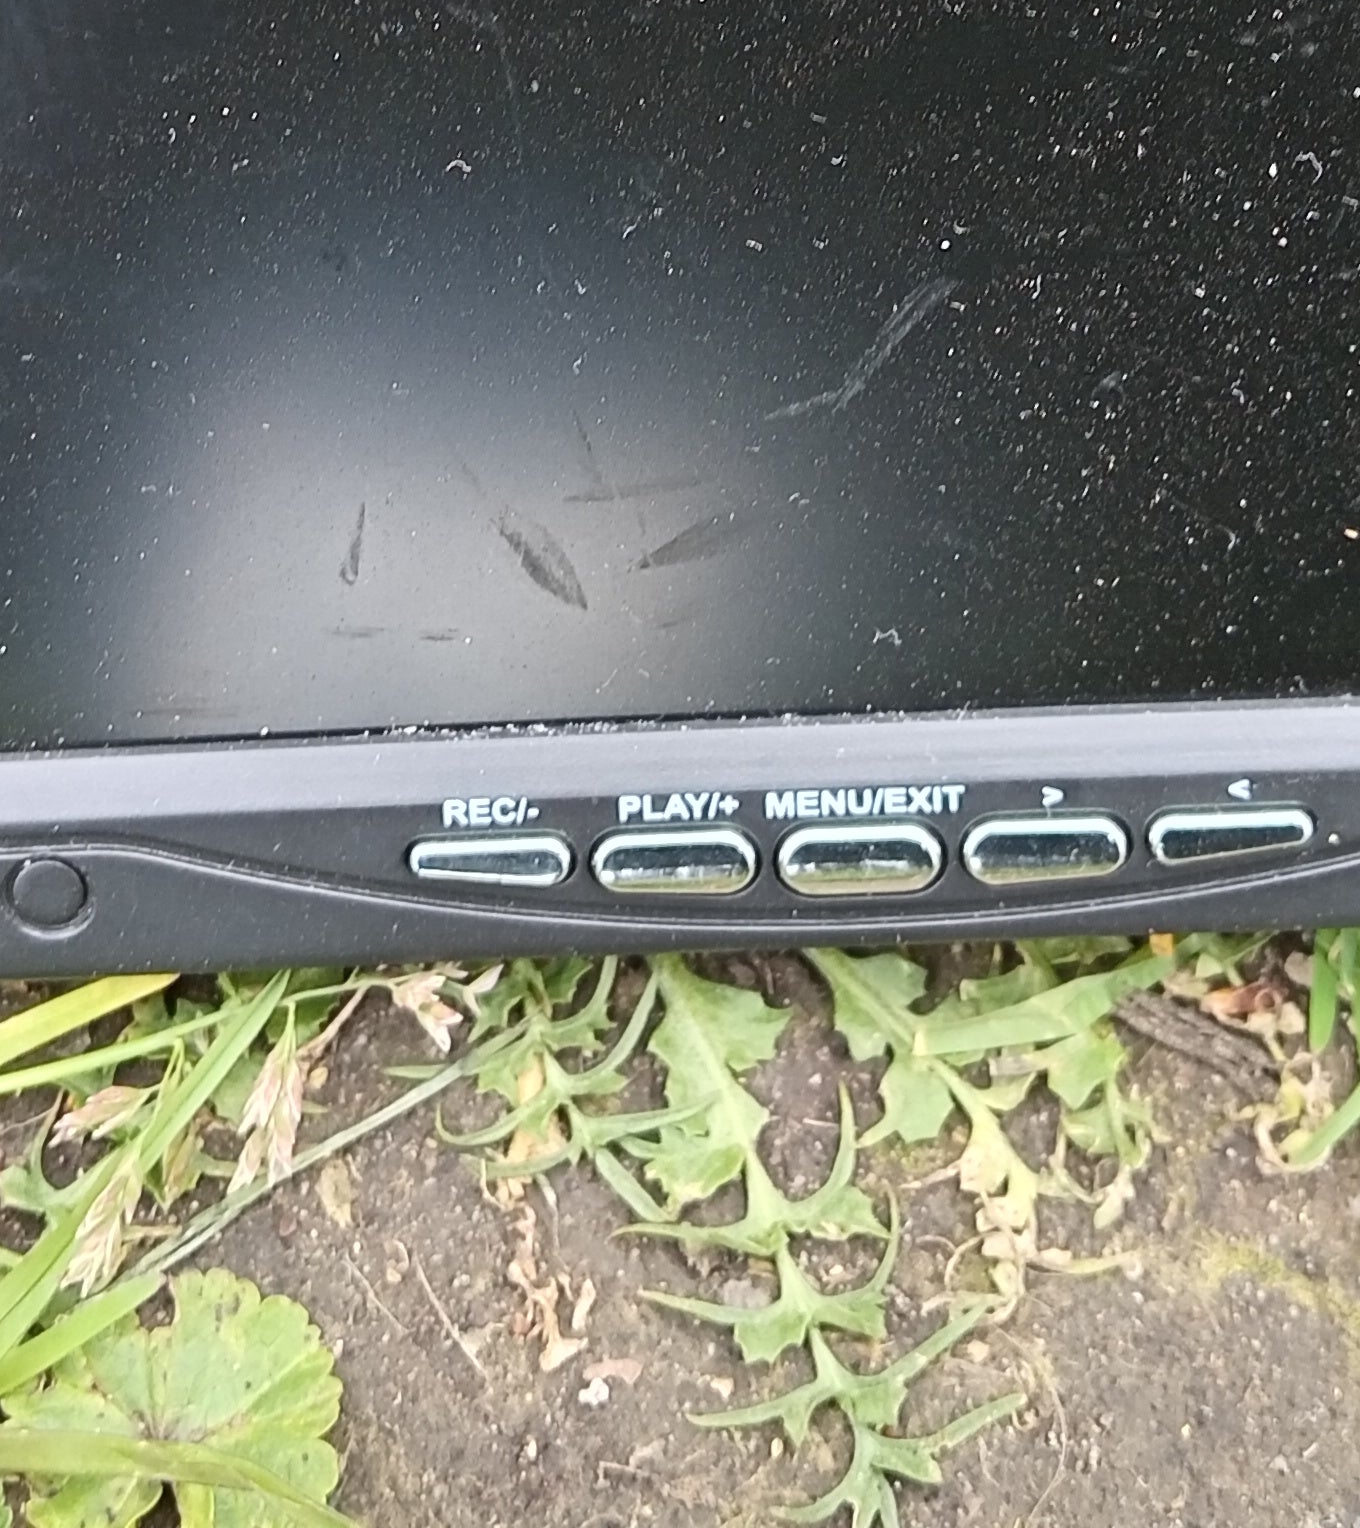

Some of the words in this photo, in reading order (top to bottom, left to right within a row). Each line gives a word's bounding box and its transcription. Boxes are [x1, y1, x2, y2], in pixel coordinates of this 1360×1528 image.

[442, 795, 540, 828] REC/-
[617, 791, 740, 823] PLAY/+
[764, 784, 967, 820] MENU/EXIT
